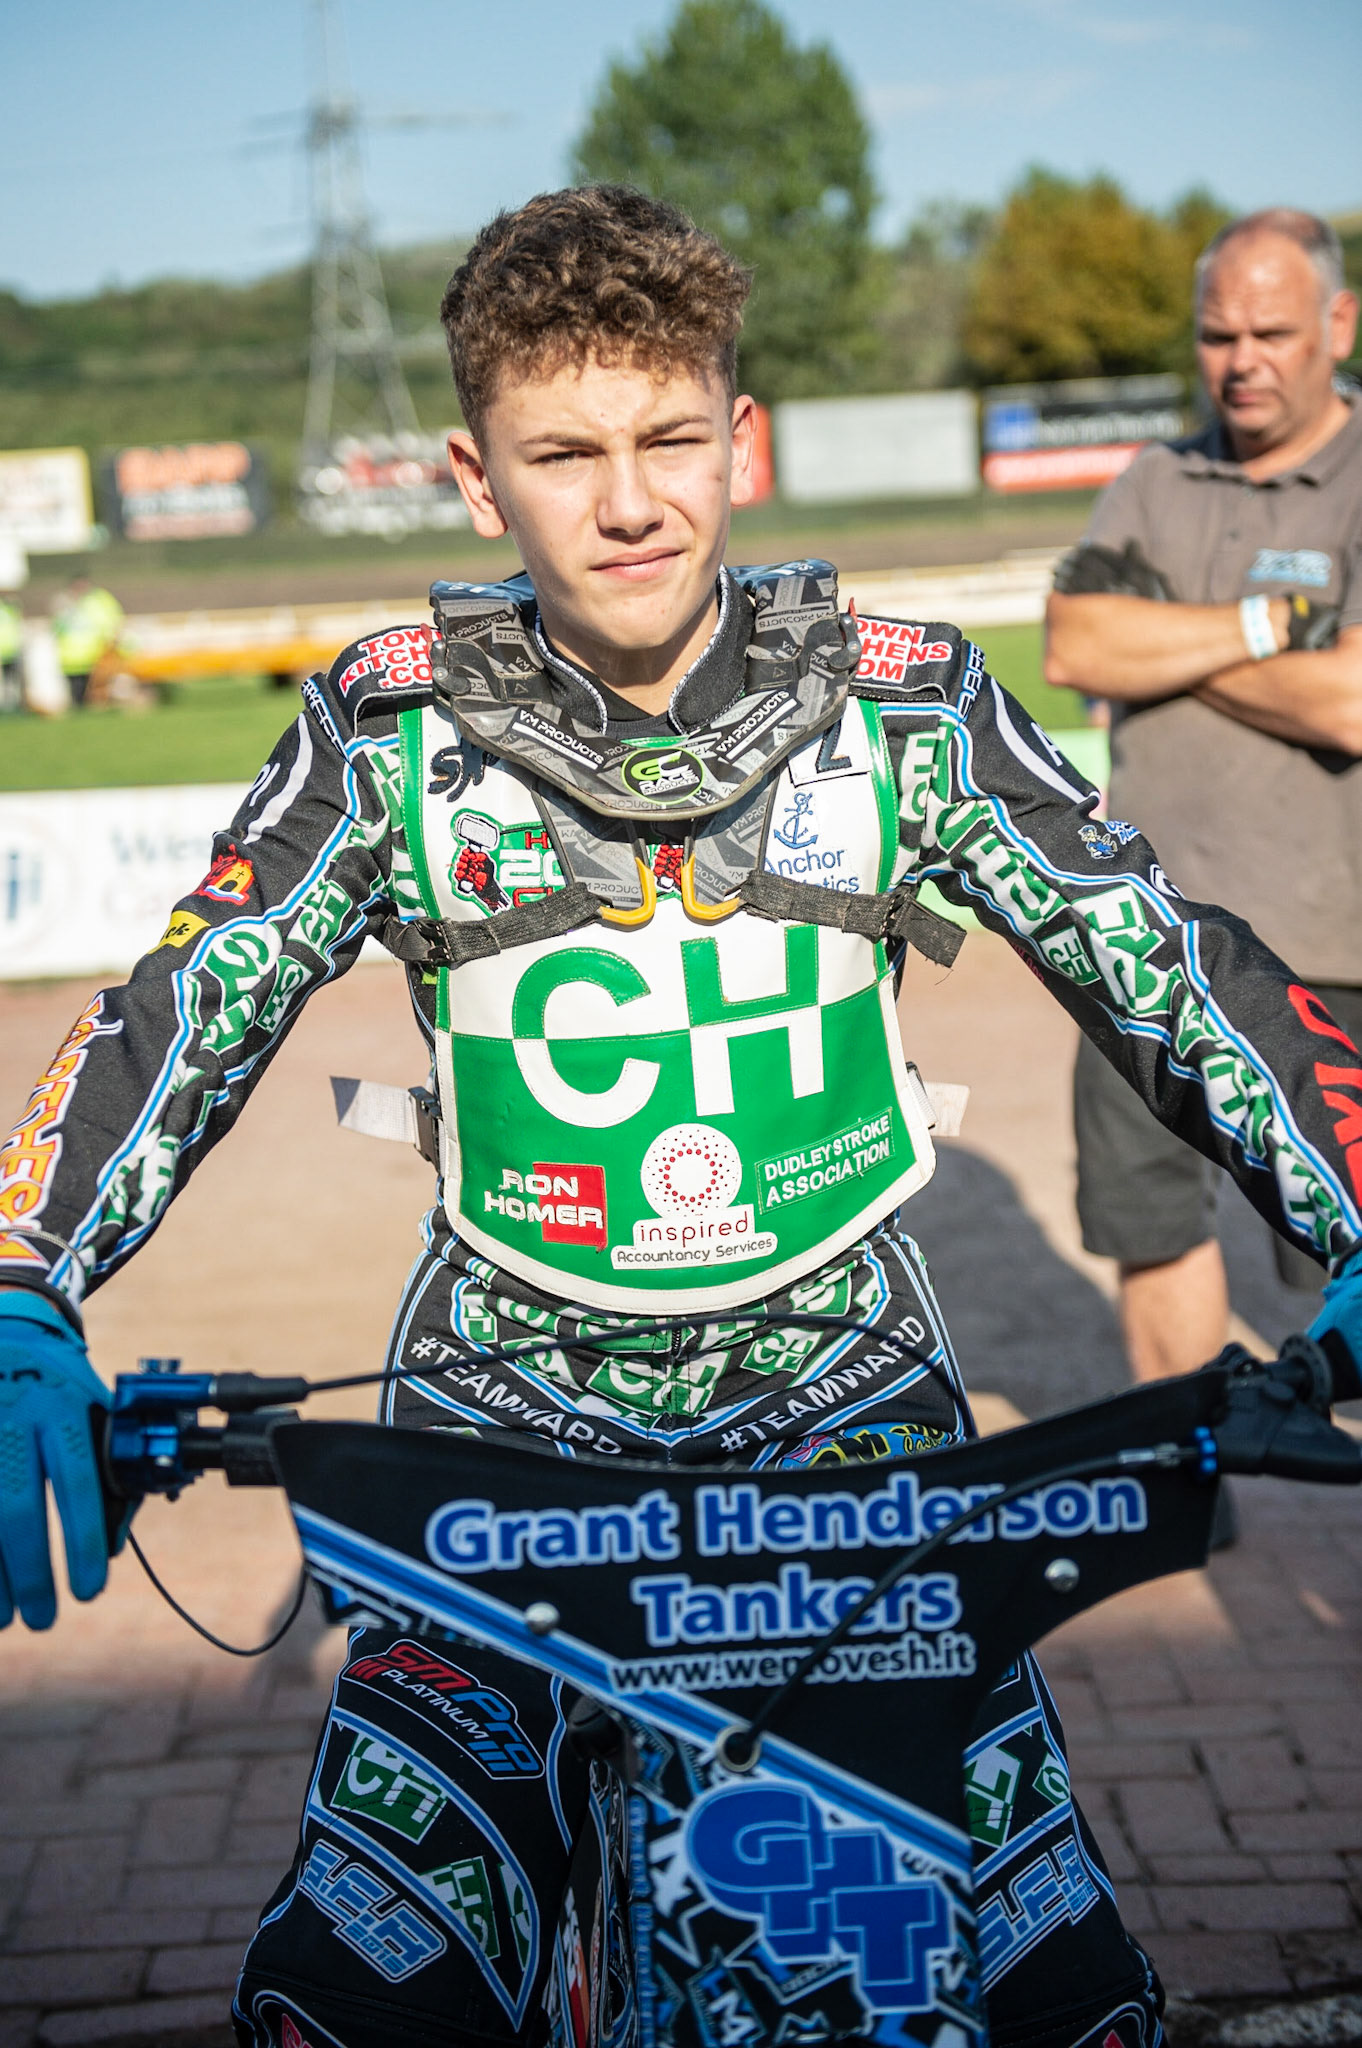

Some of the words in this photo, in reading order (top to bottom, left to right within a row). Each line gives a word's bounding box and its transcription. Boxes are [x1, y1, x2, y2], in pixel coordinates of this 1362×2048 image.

[456, 611, 508, 638] PRODUCTS
[758, 613, 815, 629] PRODUCTS
[856, 620, 922, 645] OWN
[361, 630, 443, 655] TOW
[861, 638, 950, 663] HENS
[340, 643, 432, 692] KITCH
[381, 653, 433, 688] .CO
[857, 658, 904, 681] OM
[733, 690, 790, 742] PRODUCTS
[536, 720, 605, 765] PRODUCTS
[639, 768, 696, 791] RACE
[643, 777, 700, 795] PRODUCTS
[512, 923, 824, 1128] CH
[764, 1143, 833, 1182] DUDLEY
[832, 1115, 890, 1156] STROKE
[500, 1168, 579, 1199] RON
[766, 1137, 890, 1208] ASSOCIATION
[484, 1190, 604, 1229] HOMER
[640, 1210, 749, 1248] inspired
[617, 1246, 709, 1264] Accountancy
[715, 1236, 773, 1259] Services
[719, 1315, 927, 1454] #TEAMWARD
[428, 1489, 680, 1572] Grant
[695, 1472, 1147, 1558] Henderson
[634, 1563, 962, 1647] Tankers
[380, 1668, 490, 1741] PLATINUM
[685, 1780, 952, 2012] GHT
